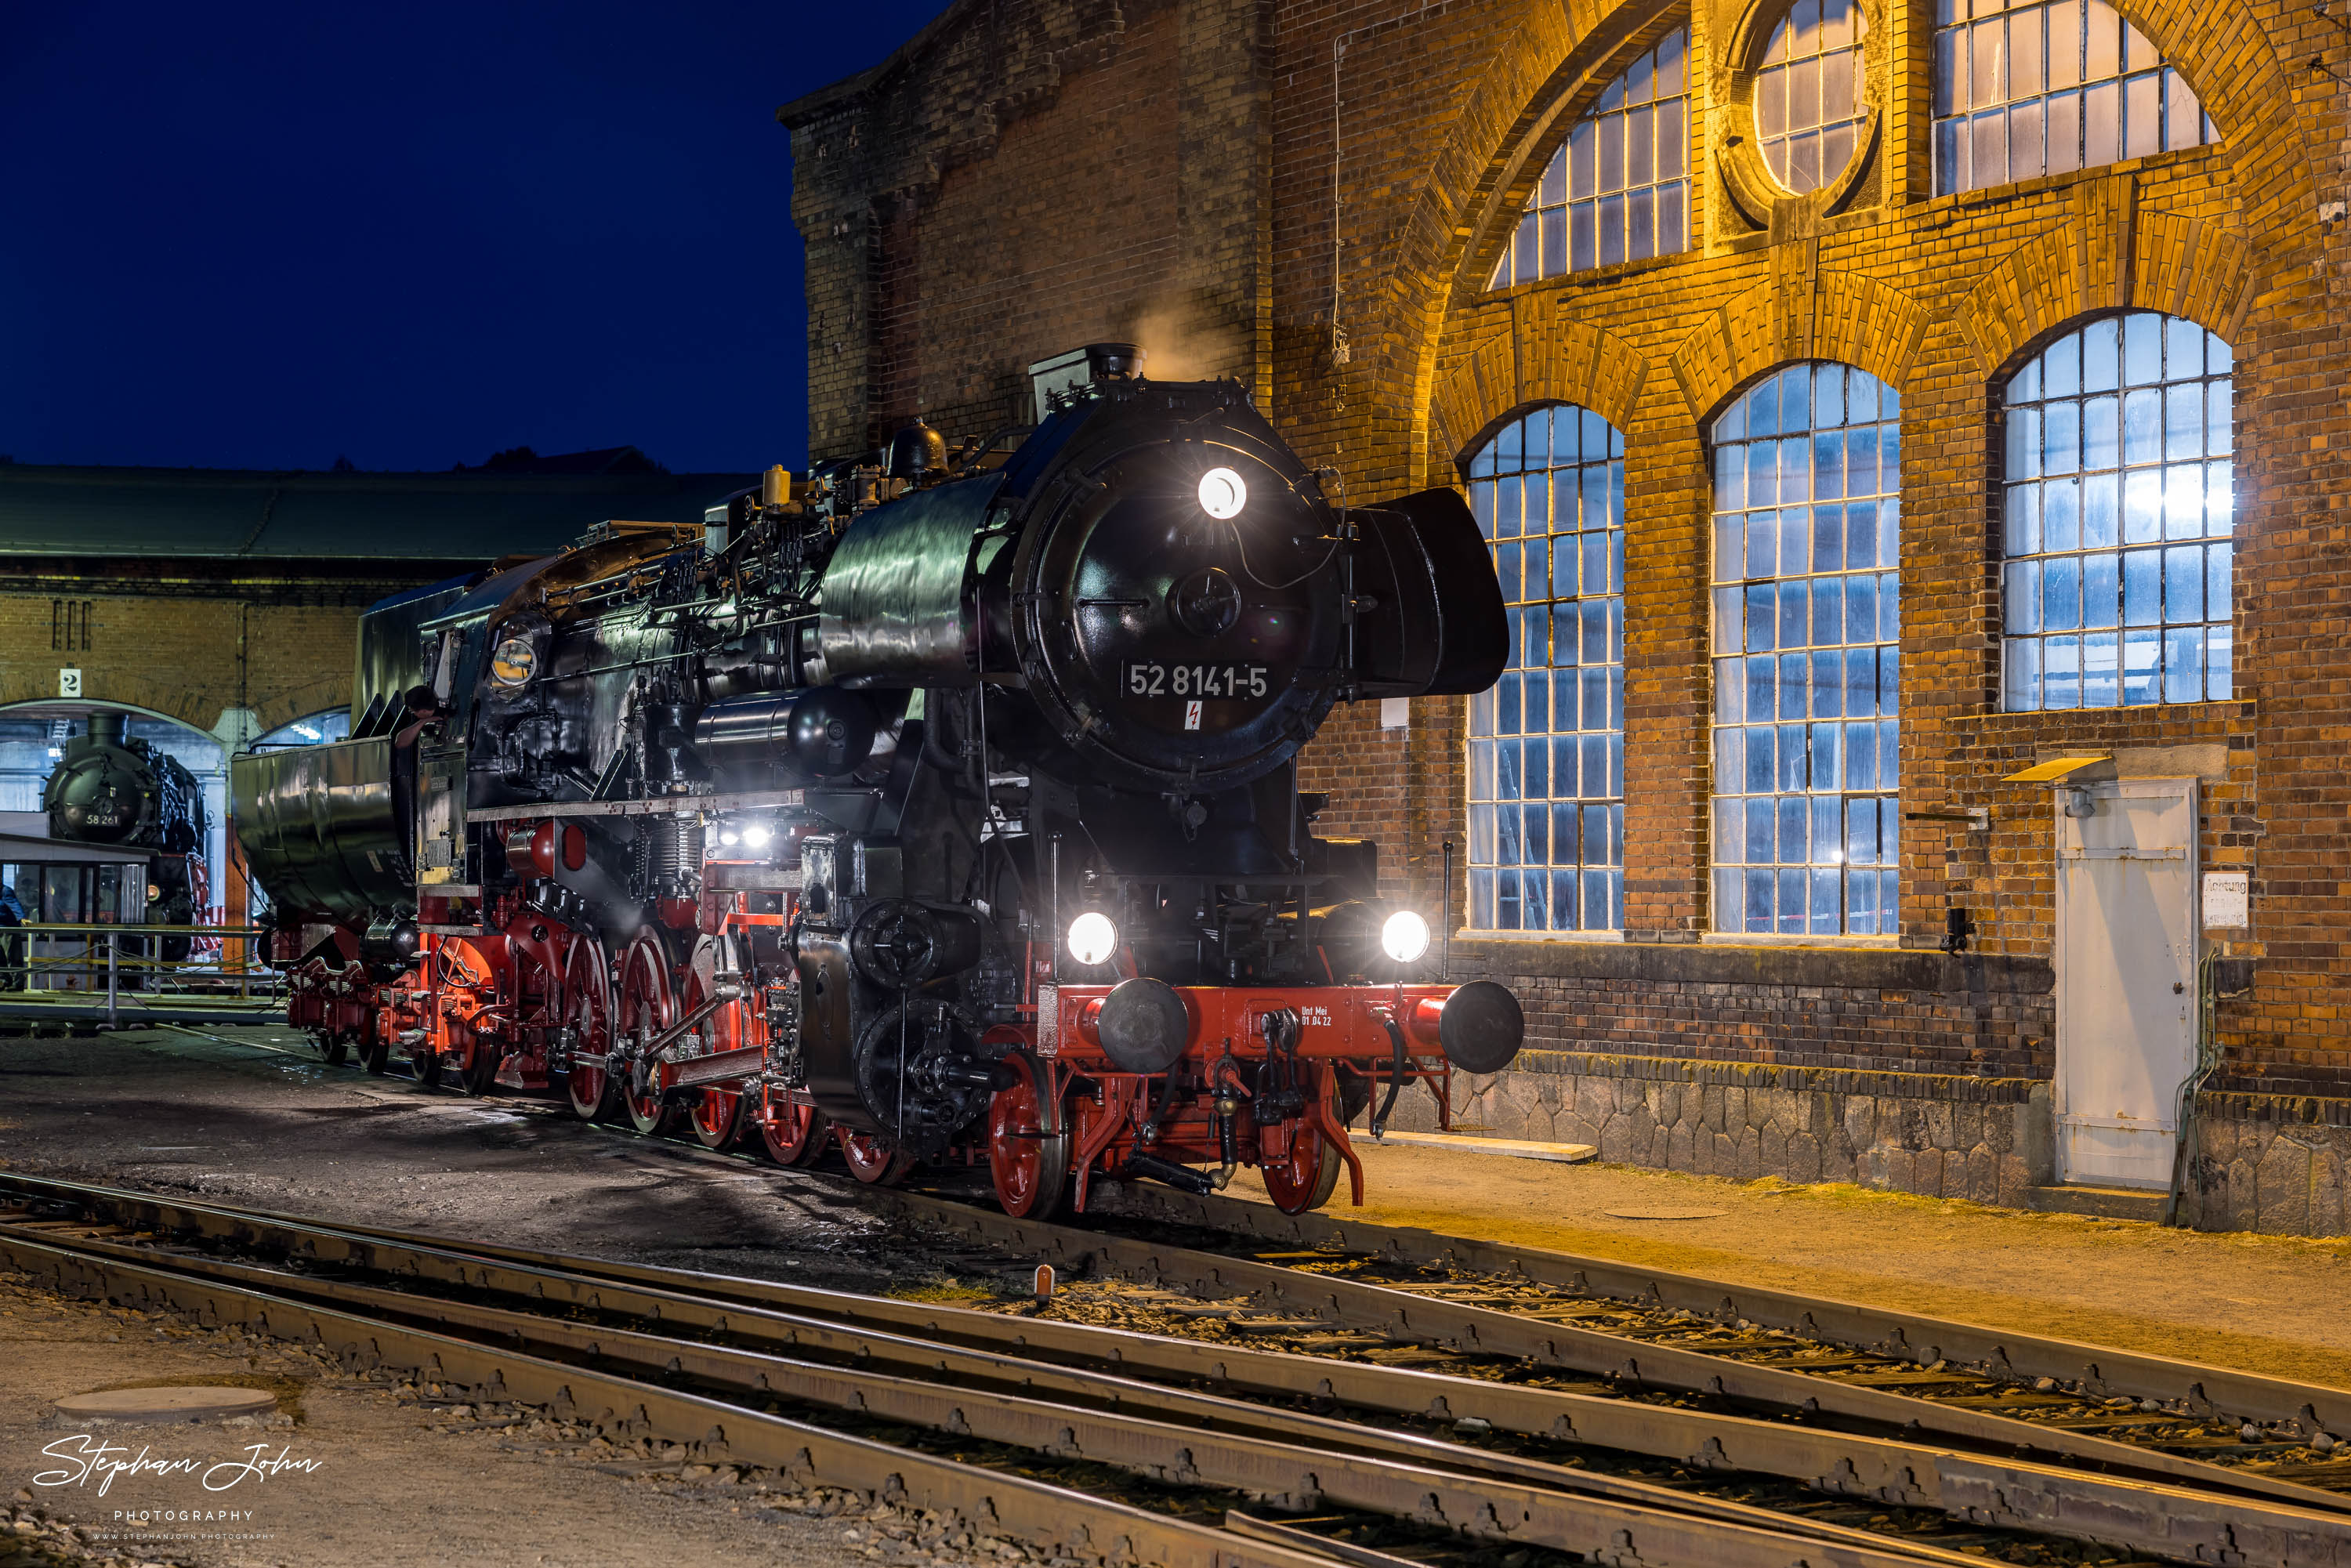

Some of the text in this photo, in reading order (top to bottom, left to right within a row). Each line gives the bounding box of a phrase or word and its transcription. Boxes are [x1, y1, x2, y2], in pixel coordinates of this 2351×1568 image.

[63, 674, 78, 691] 2
[1131, 664, 1267, 697] 52 8141-5
[86, 814, 118, 824] 58 261
[1302, 1005, 1328, 1016] Unt Mei
[1323, 1016, 1331, 1026] 22
